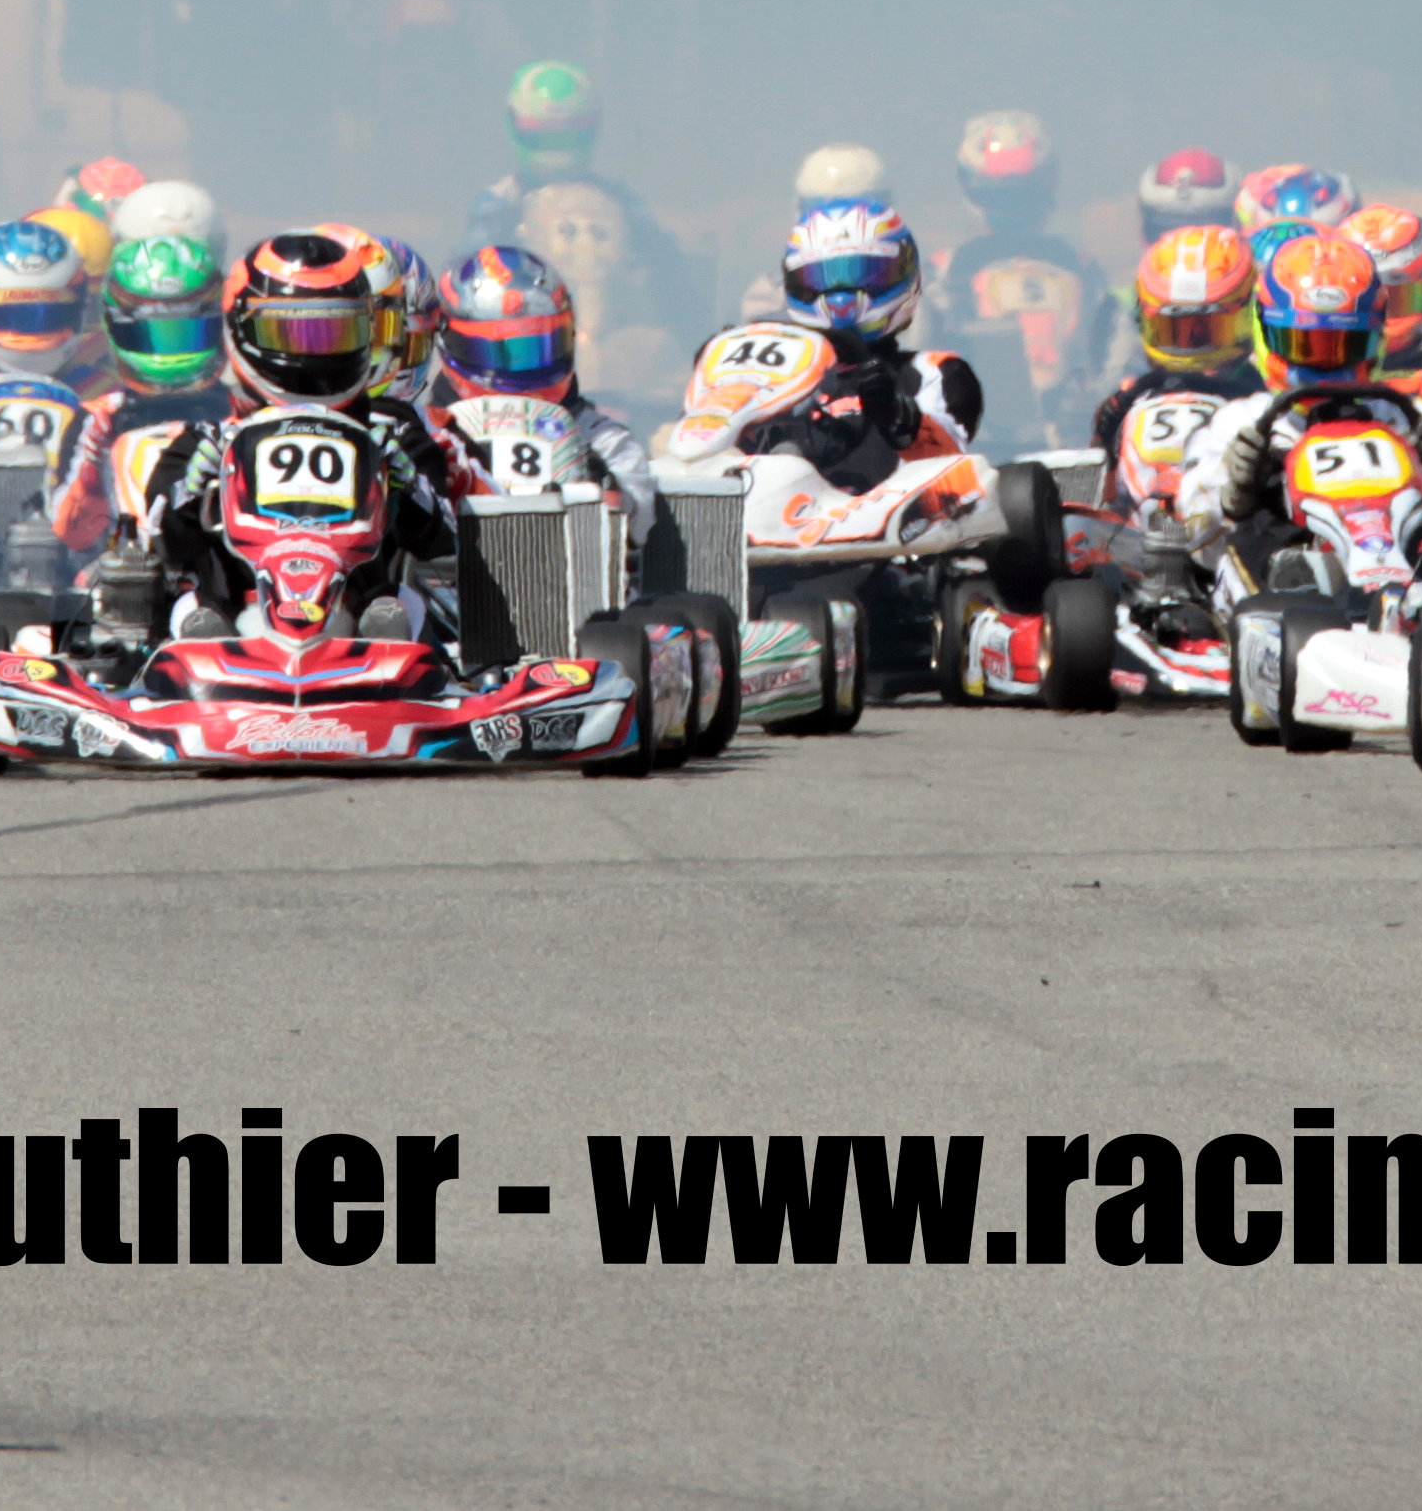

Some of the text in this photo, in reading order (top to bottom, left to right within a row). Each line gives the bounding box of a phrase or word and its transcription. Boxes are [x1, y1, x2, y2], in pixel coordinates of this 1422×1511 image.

[722, 340, 788, 368] 46
[268, 442, 344, 484] 90
[1314, 439, 1382, 475] 51
